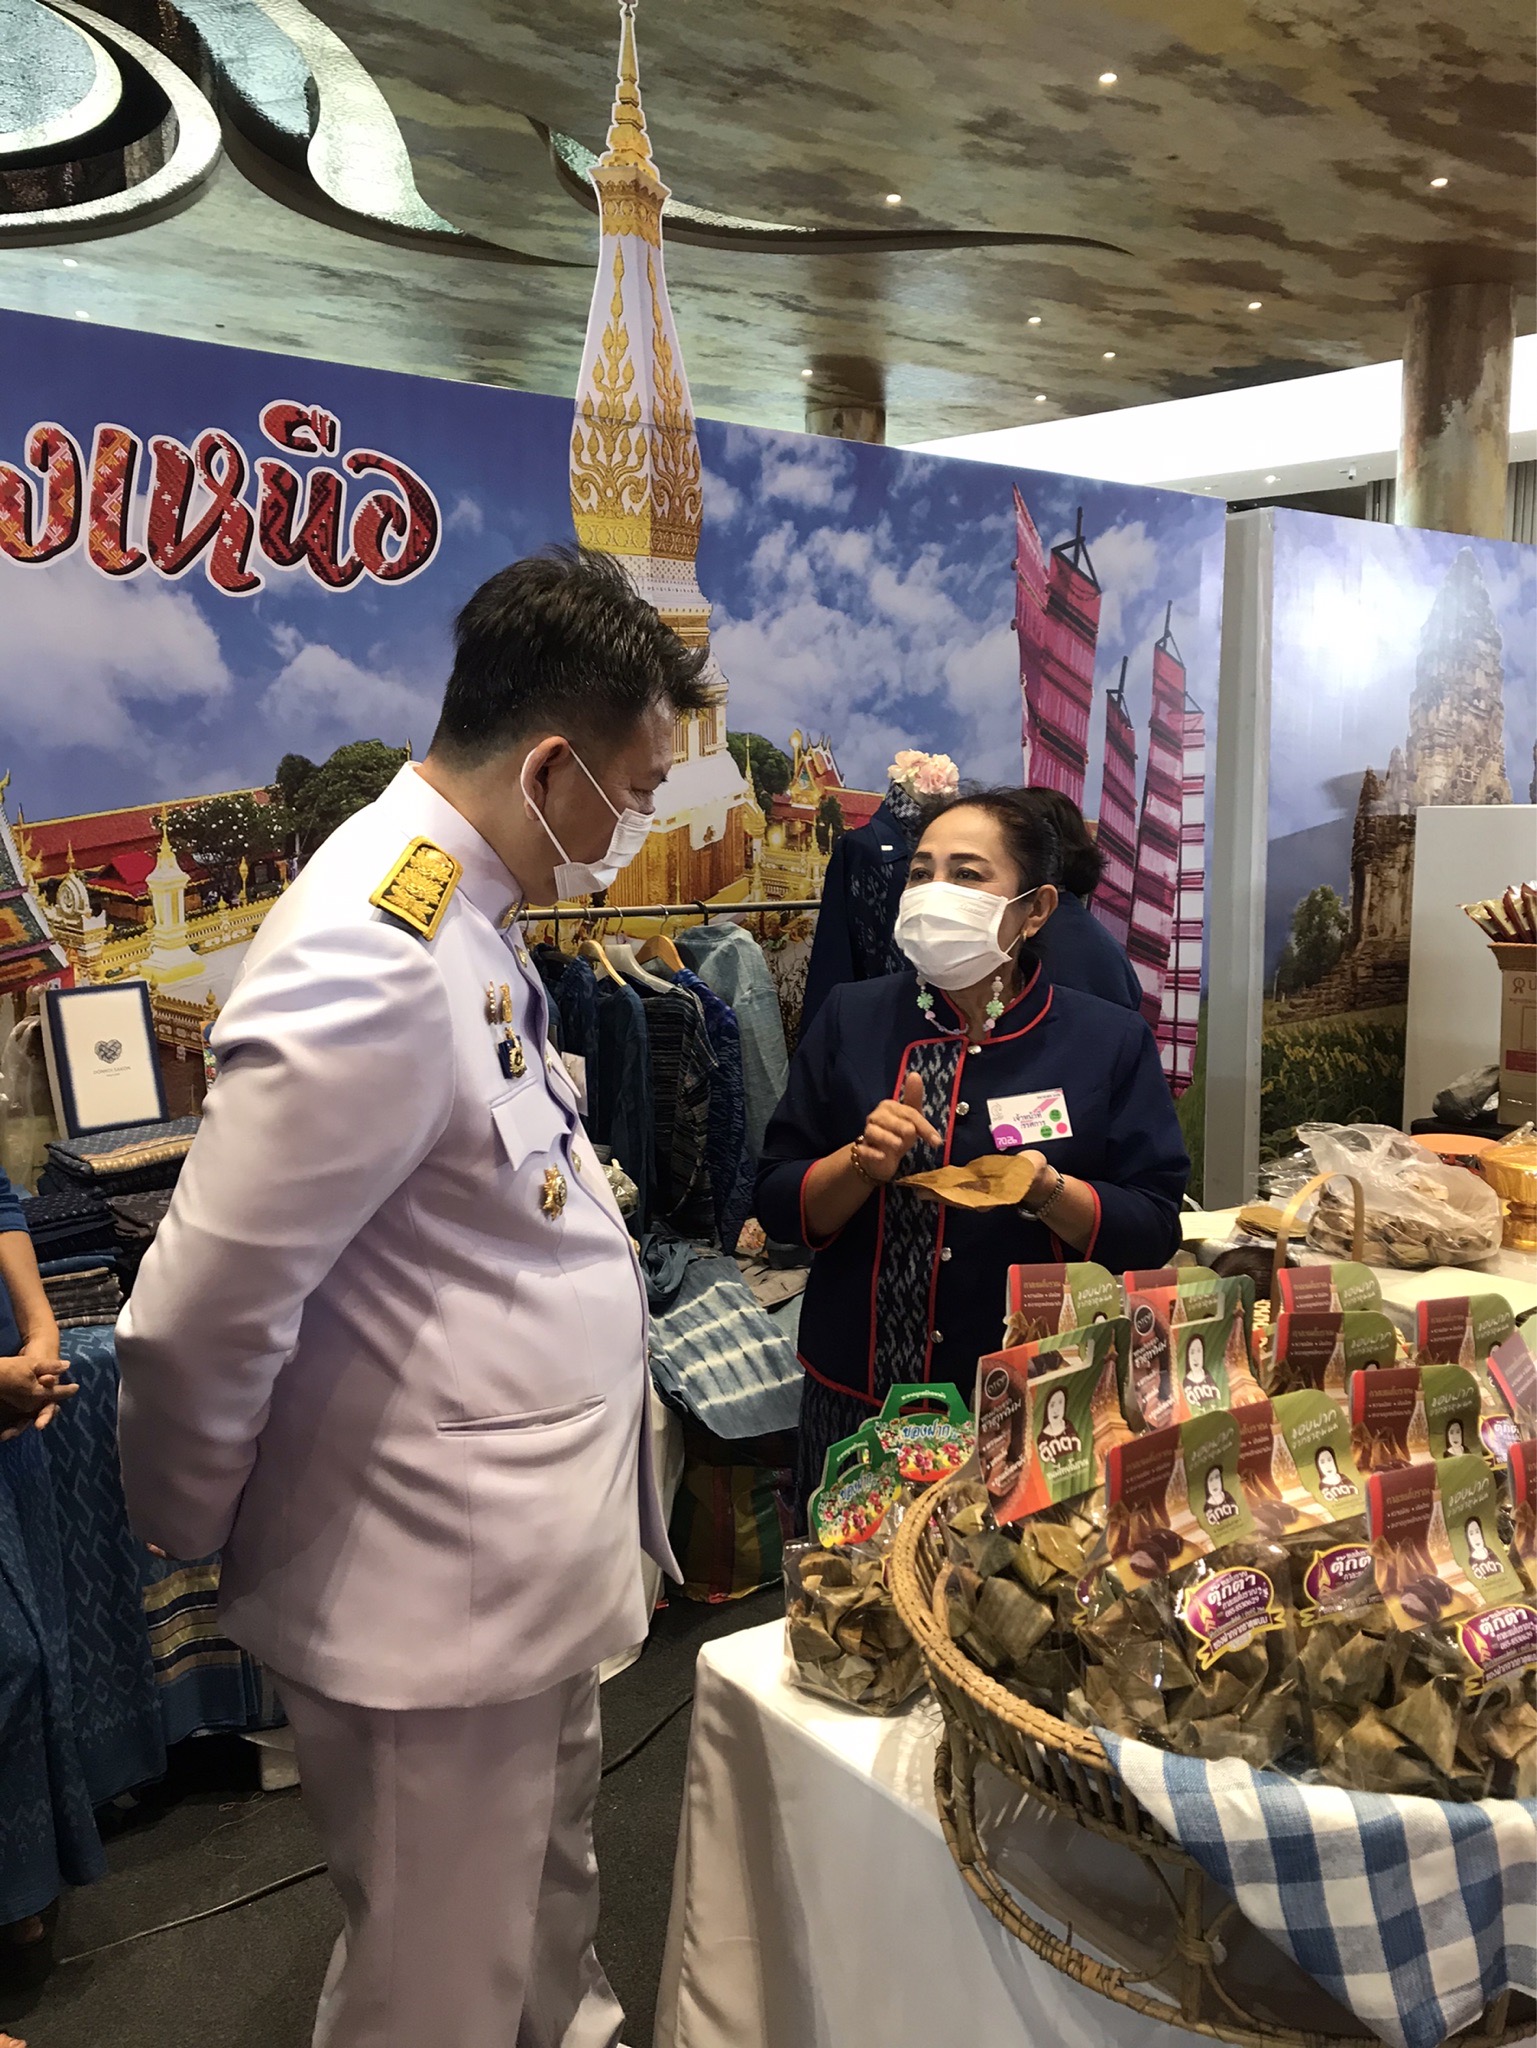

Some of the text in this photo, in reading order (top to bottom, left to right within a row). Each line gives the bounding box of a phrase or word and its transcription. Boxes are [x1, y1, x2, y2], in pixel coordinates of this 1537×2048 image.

[902, 1418, 951, 1439] ของฝาก
[1207, 1574, 1256, 1606] ตุ๊กตา
[1479, 1609, 1528, 1637] ตุ๊กตา
